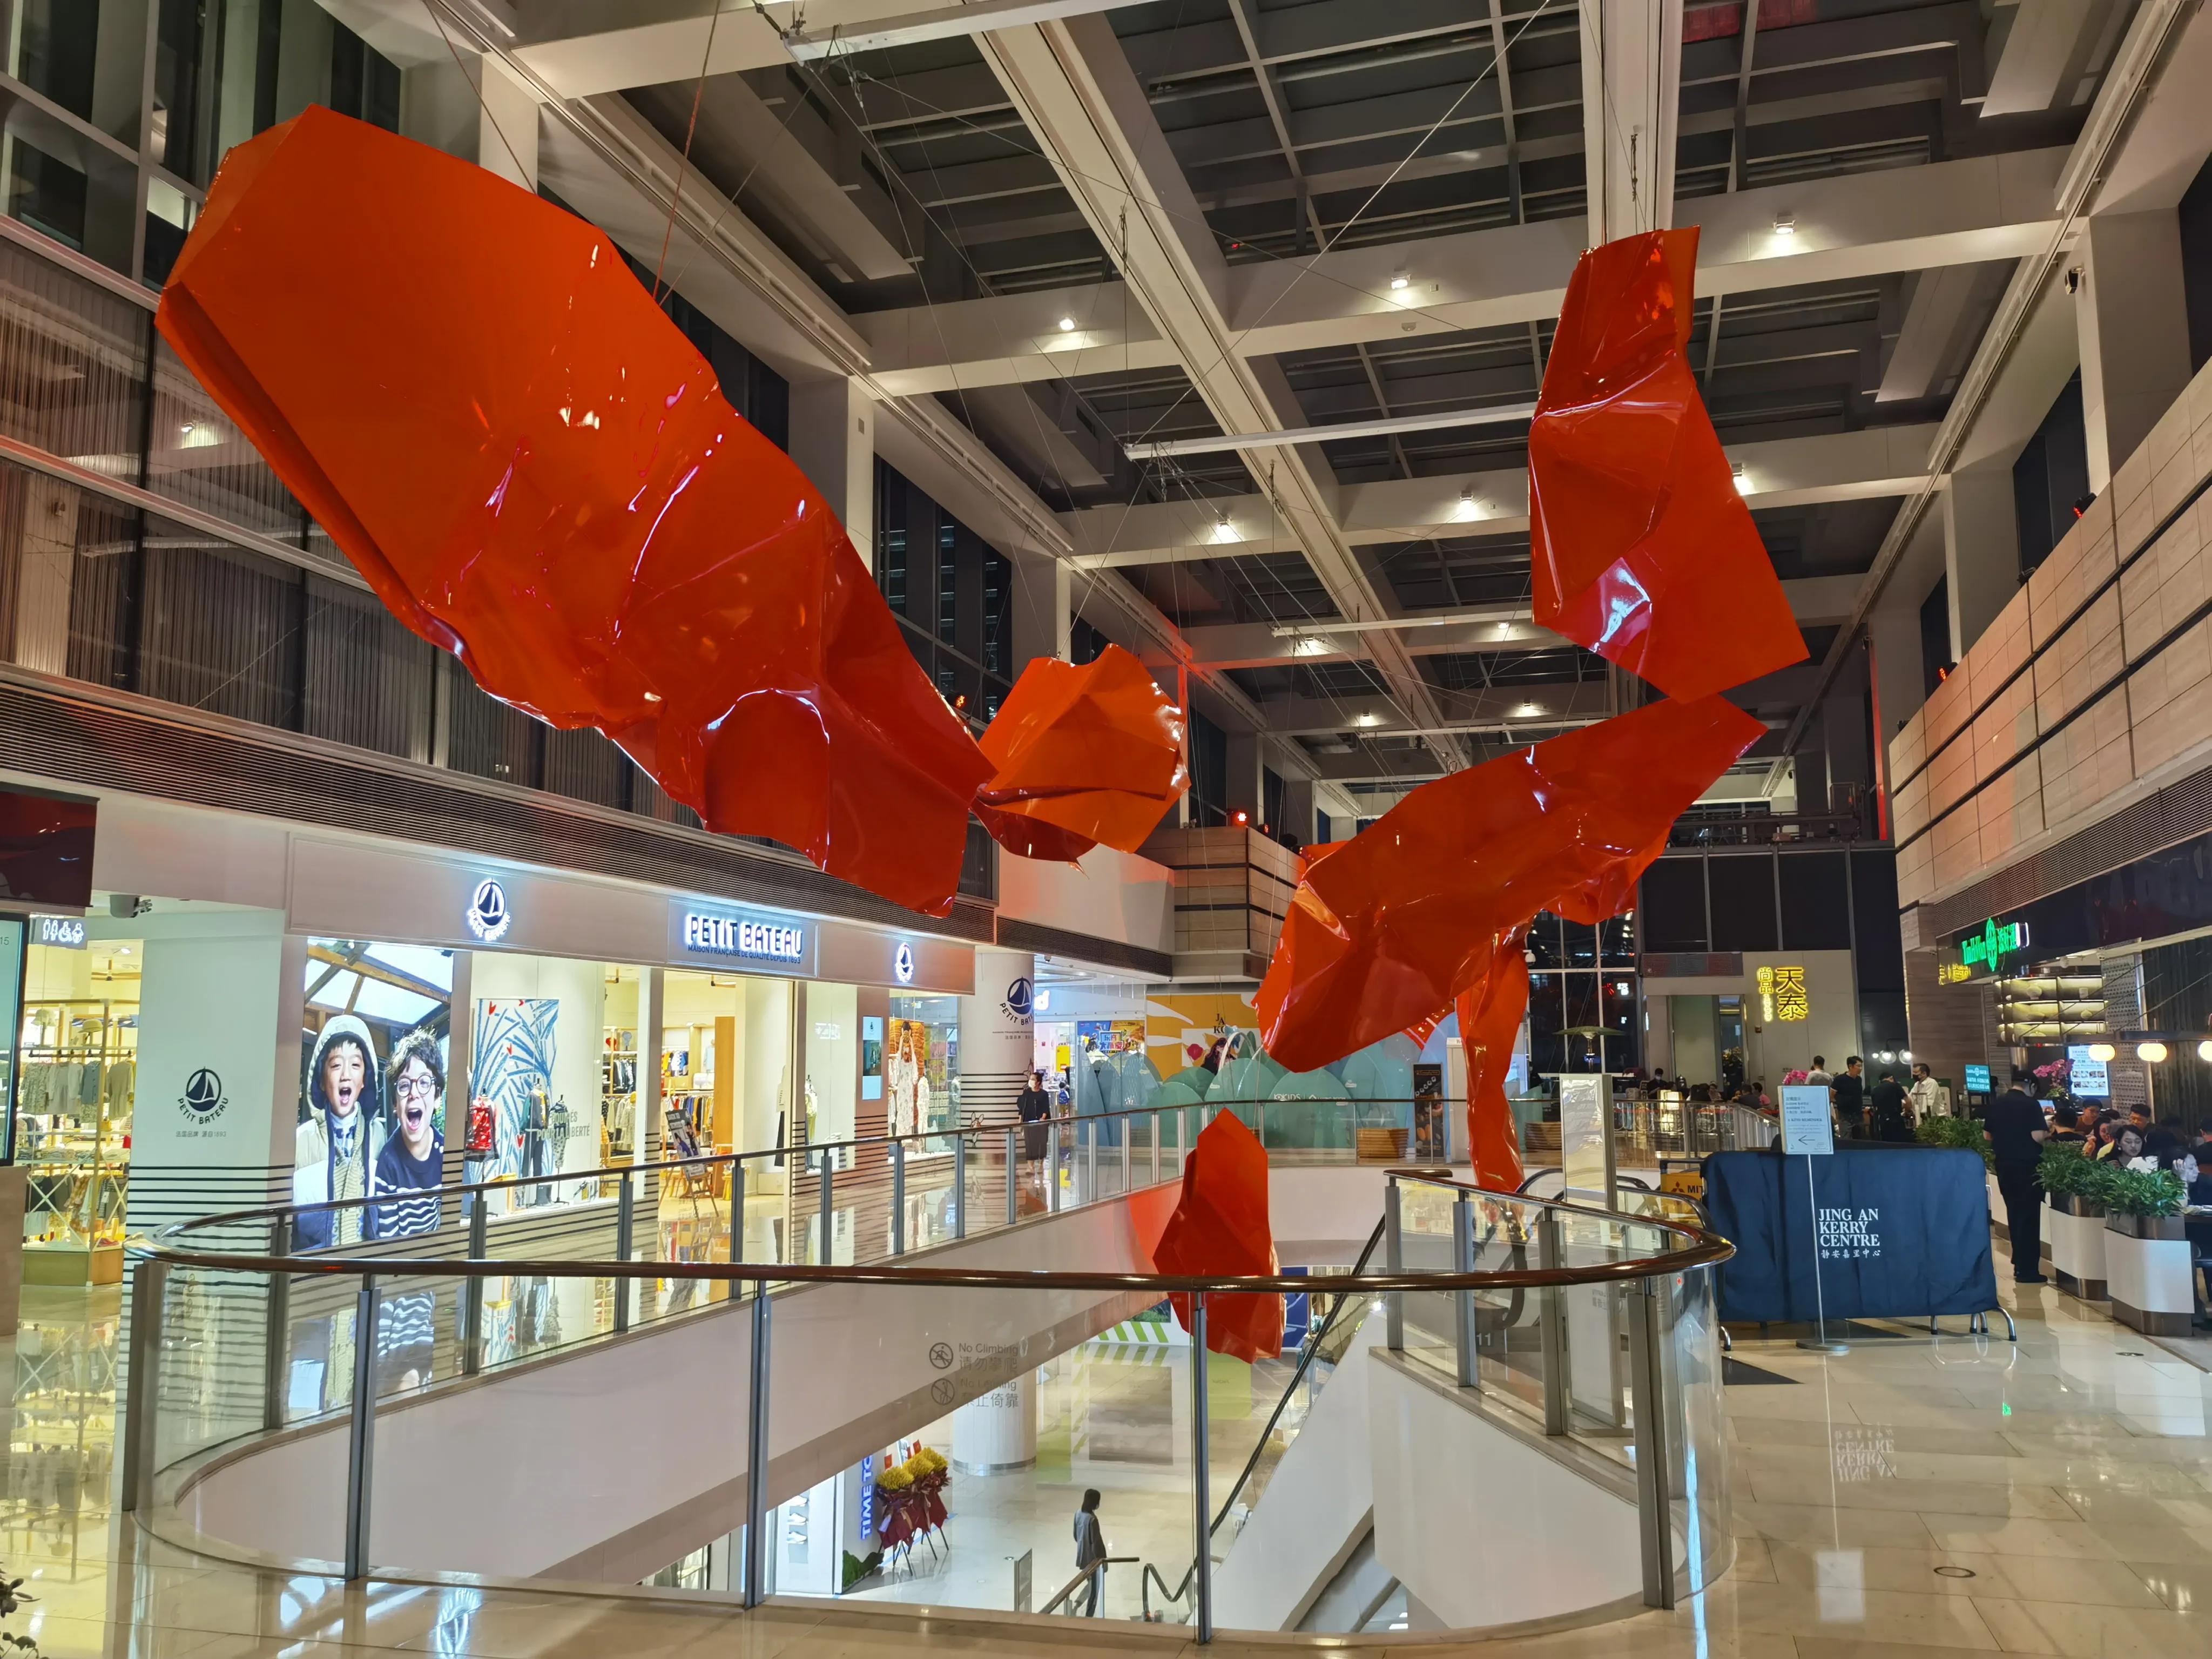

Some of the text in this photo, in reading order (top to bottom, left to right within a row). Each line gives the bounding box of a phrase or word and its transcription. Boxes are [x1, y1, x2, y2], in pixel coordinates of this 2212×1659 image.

[687, 915, 803, 957] PETIT BATEAU
[688, 945, 710, 953] MAISON
[710, 947, 740, 959] FRANÇAISE
[770, 954, 787, 963] DEPUIS
[1776, 967, 1807, 1020] 天泰
[1000, 1003, 1018, 1023] PETIT
[177, 1097, 229, 1124] PETIT BATEAU
[1819, 1209, 1878, 1220] JING AN
[1819, 1221, 1868, 1233] KERRY
[1820, 1234, 1880, 1247] CENTRE
[959, 1343, 1019, 1357] No Climbing
[960, 1356, 1018, 1374] 请勿攀爬
[861, 1485, 872, 1540] TIME
